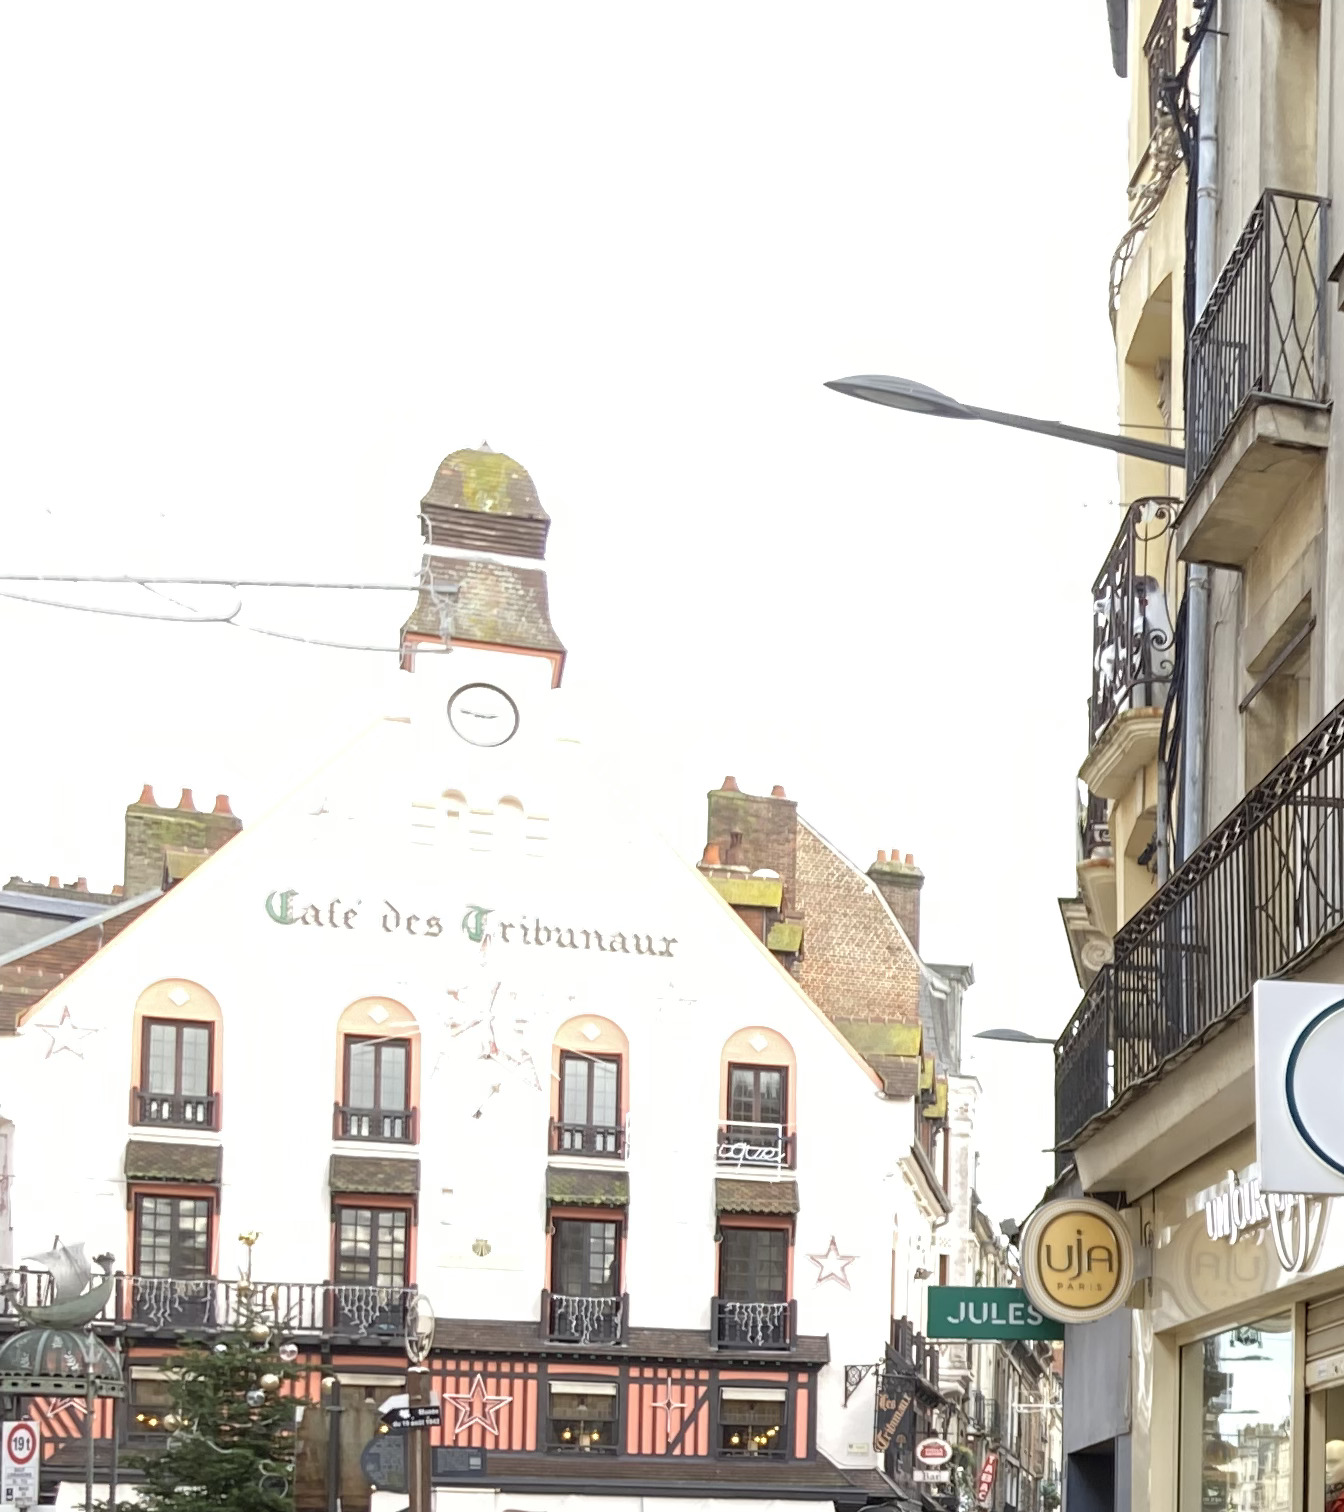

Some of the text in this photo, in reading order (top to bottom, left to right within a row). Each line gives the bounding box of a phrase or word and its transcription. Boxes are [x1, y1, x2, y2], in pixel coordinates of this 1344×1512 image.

[380, 899, 444, 938] des
[461, 903, 679, 958] Tribunaux
[1057, 1281, 1103, 1292] PARIS
[947, 1301, 1044, 1327] JULES
[978, 1455, 996, 1500] TABAC
